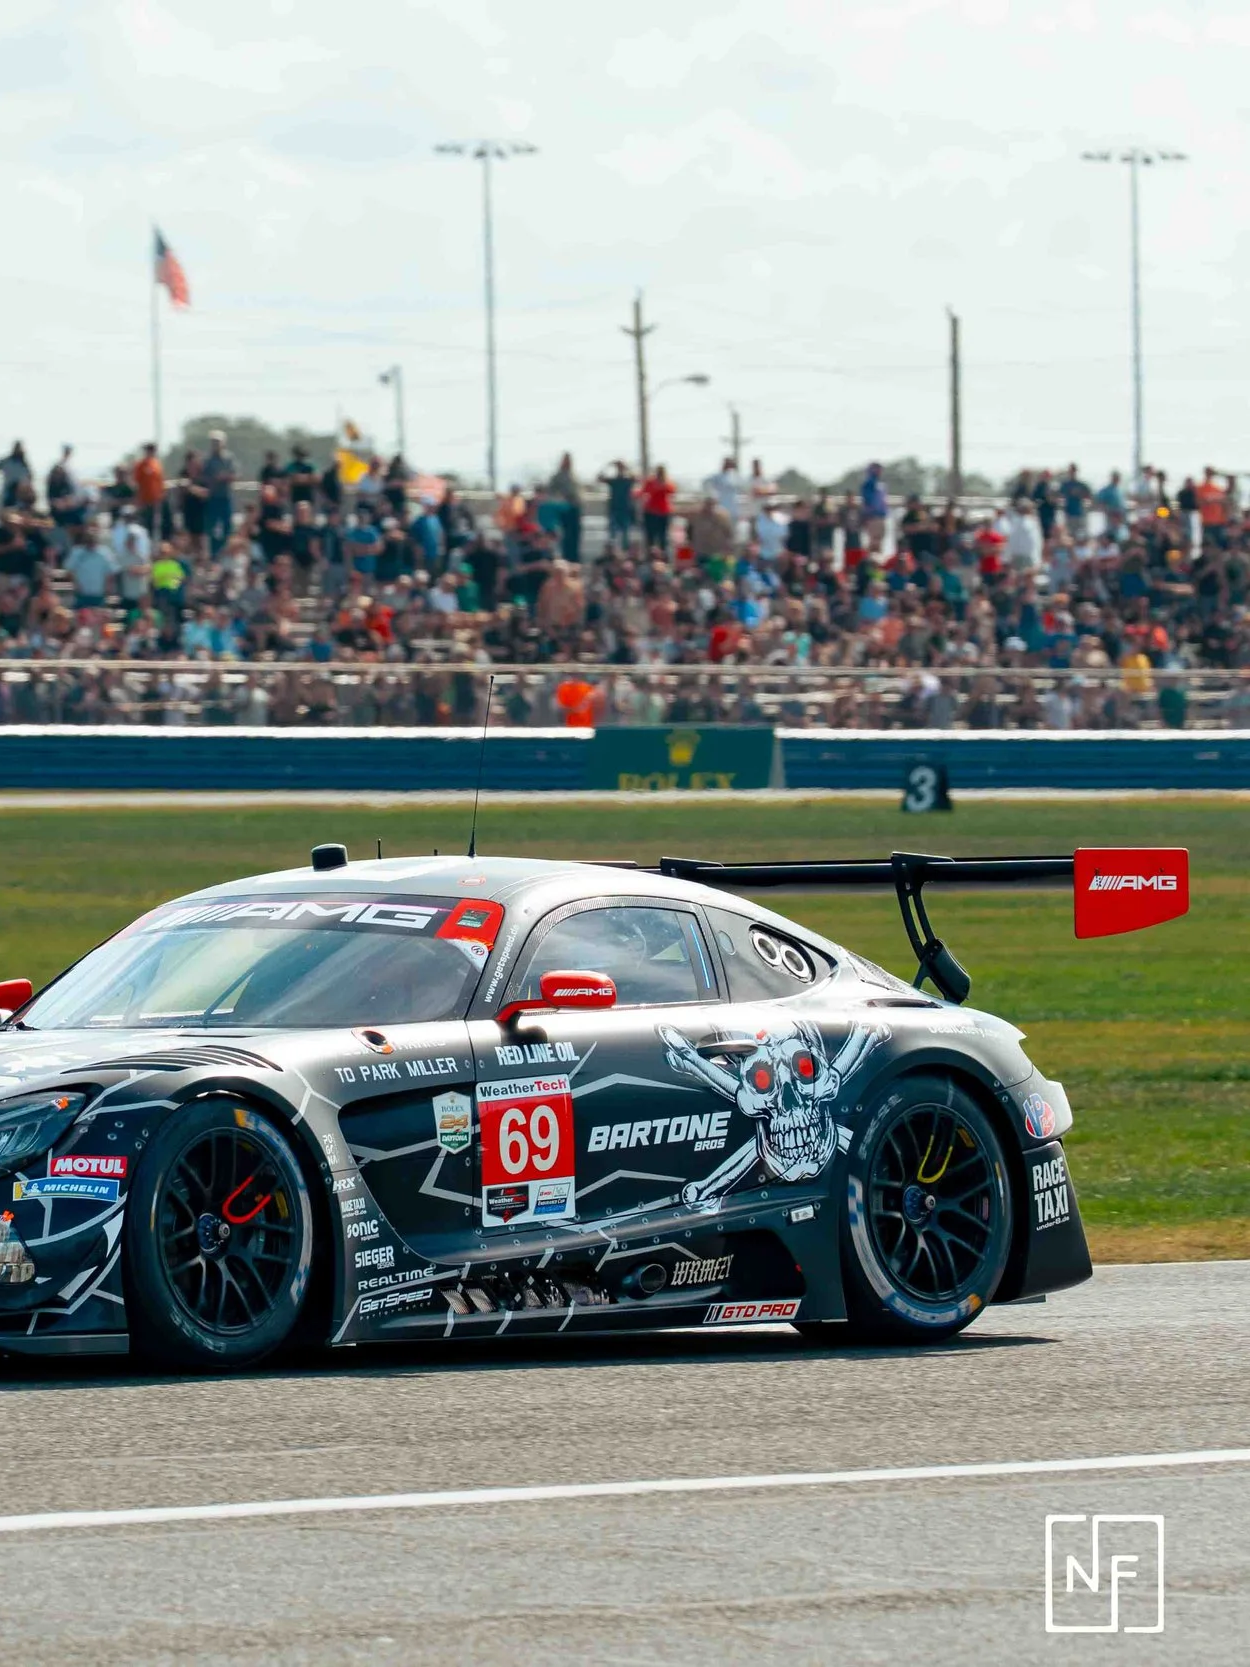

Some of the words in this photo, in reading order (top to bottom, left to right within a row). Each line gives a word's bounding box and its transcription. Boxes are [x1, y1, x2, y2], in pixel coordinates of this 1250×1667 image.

[617, 771, 736, 790] ROLEX
[906, 765, 937, 813] 3
[1114, 875, 1177, 890] AMG
[208, 901, 438, 929] AMG
[484, 923, 520, 1003] www.getspeed.de
[572, 988, 613, 997] AMG
[494, 1044, 524, 1066] RED
[525, 1042, 557, 1064] LINE
[556, 1041, 580, 1062] OIL
[335, 1067, 356, 1083] TO
[359, 1062, 401, 1082] PARK
[405, 1057, 459, 1077] MILLER
[480, 1078, 568, 1098] WeatherTech
[441, 1104, 465, 1113] ROLEX
[439, 1113, 469, 1130] 24
[441, 1133, 468, 1142] DAYTONA
[498, 1104, 560, 1175] 69
[587, 1111, 732, 1152] BARTONE
[693, 1138, 727, 1152] BROS
[54, 1157, 125, 1174] MOTUL
[1032, 1156, 1066, 1192] RACE
[43, 1183, 110, 1194] MICHELIN
[332, 1177, 356, 1192] HRX
[1034, 1184, 1069, 1223] TAXI
[1036, 1216, 1070, 1231] under8.de
[354, 1245, 395, 1268] SIEGER
[357, 1267, 436, 1291] REALTIME
[721, 1305, 756, 1319] GTD
[758, 1303, 796, 1317] PRO
